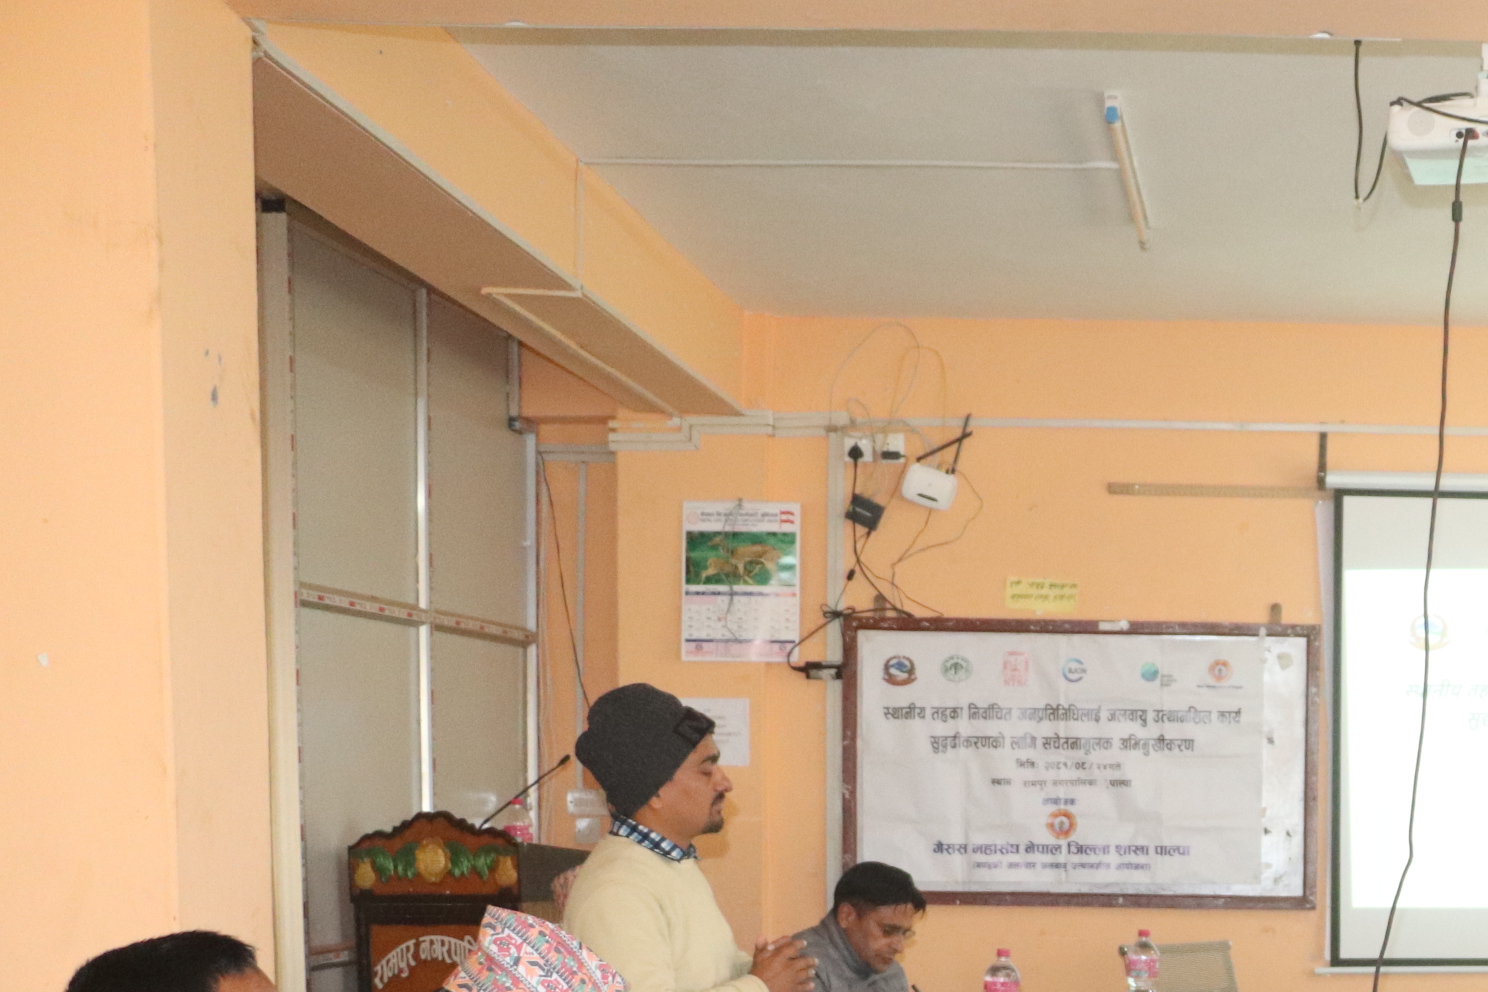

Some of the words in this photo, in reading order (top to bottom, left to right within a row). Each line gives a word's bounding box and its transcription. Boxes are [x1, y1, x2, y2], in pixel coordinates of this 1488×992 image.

[931, 705, 962, 722] तहका
[1025, 840, 1063, 856] नेपाल
[374, 939, 417, 989] रामपुर
